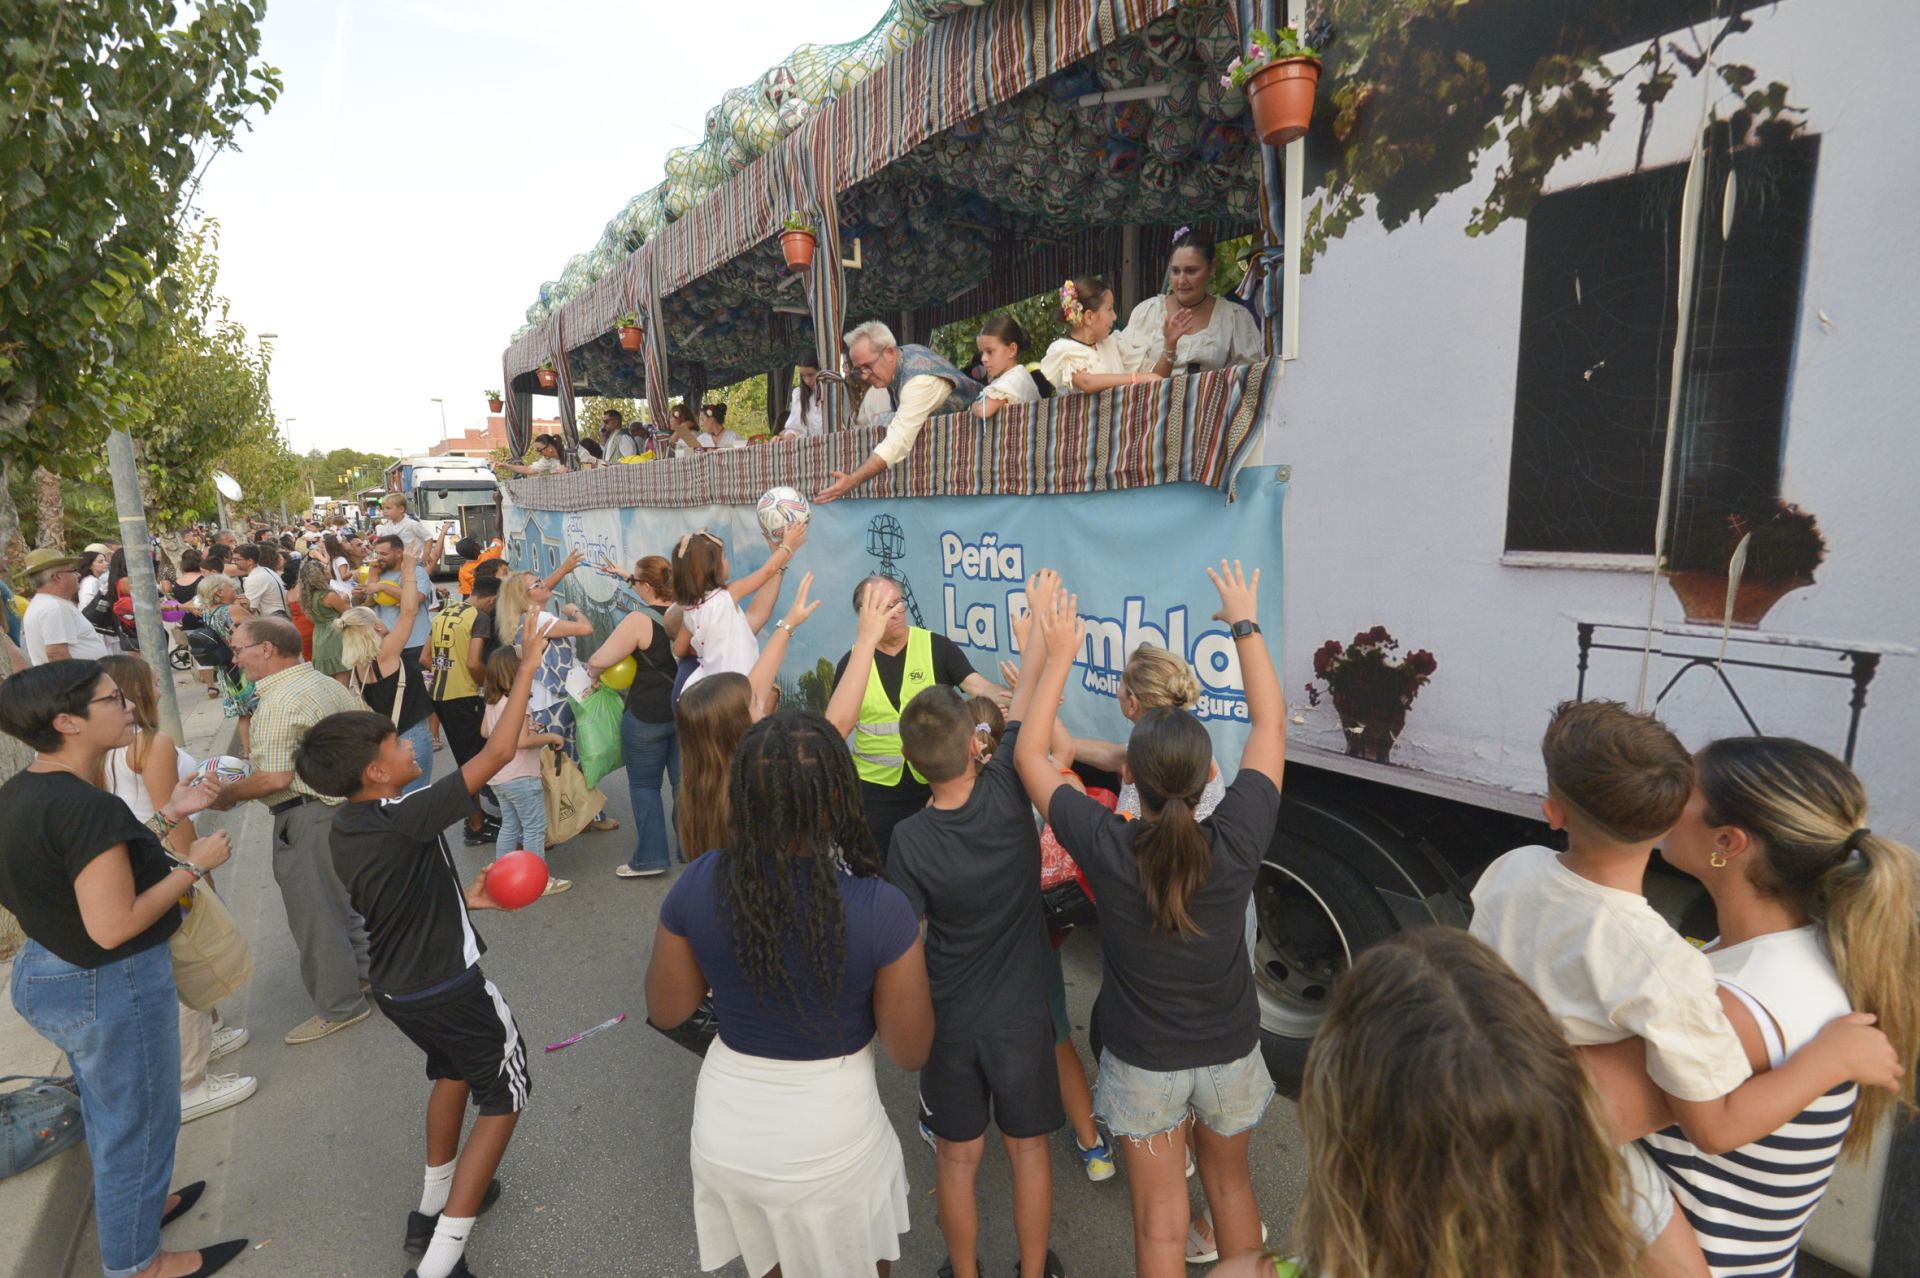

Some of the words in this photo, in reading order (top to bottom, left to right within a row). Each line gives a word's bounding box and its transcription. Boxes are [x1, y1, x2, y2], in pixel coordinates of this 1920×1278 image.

[941, 531, 1024, 582] Peña
[943, 584, 998, 652] La
[1006, 588, 1247, 695] mbla
[1083, 667, 1121, 697] Moli
[1191, 691, 1250, 721] gura
